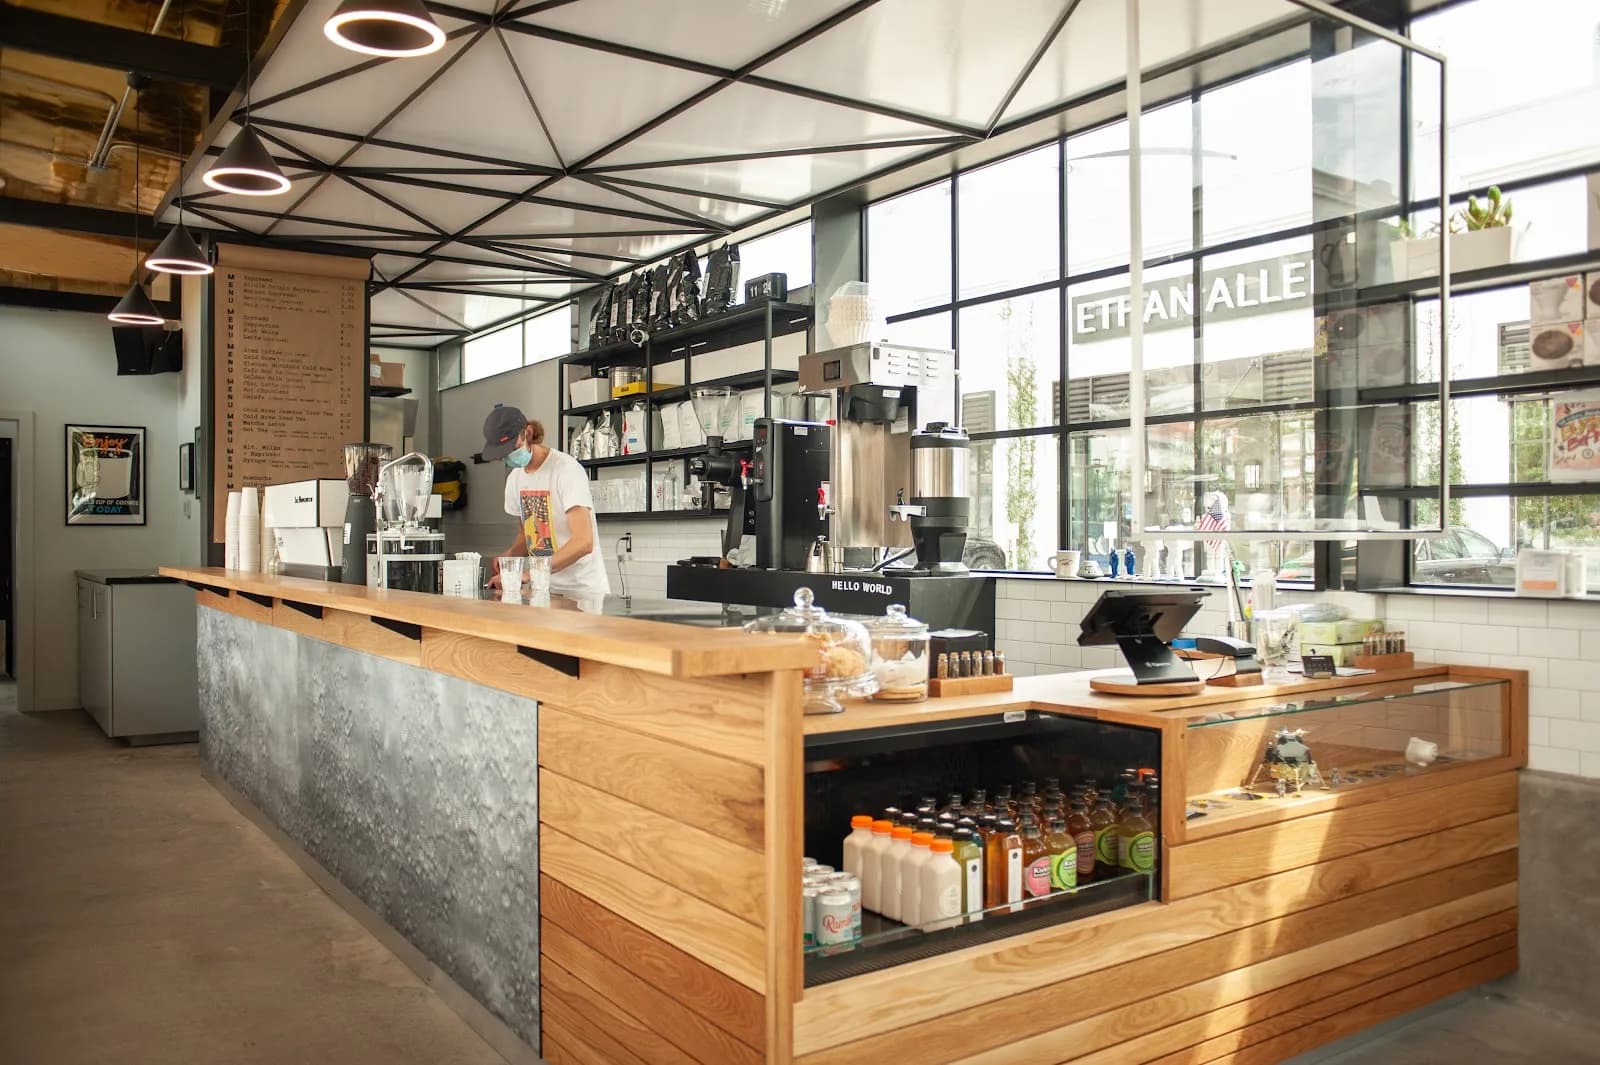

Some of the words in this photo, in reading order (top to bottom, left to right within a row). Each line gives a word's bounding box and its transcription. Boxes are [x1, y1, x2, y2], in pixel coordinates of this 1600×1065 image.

[227, 273, 235, 303] MENU
[1205, 259, 1314, 312] ALLE
[227, 308, 235, 338] MENU
[227, 343, 235, 373] MENU
[831, 580, 860, 591] HELLO
[862, 582, 893, 595] WORLD
